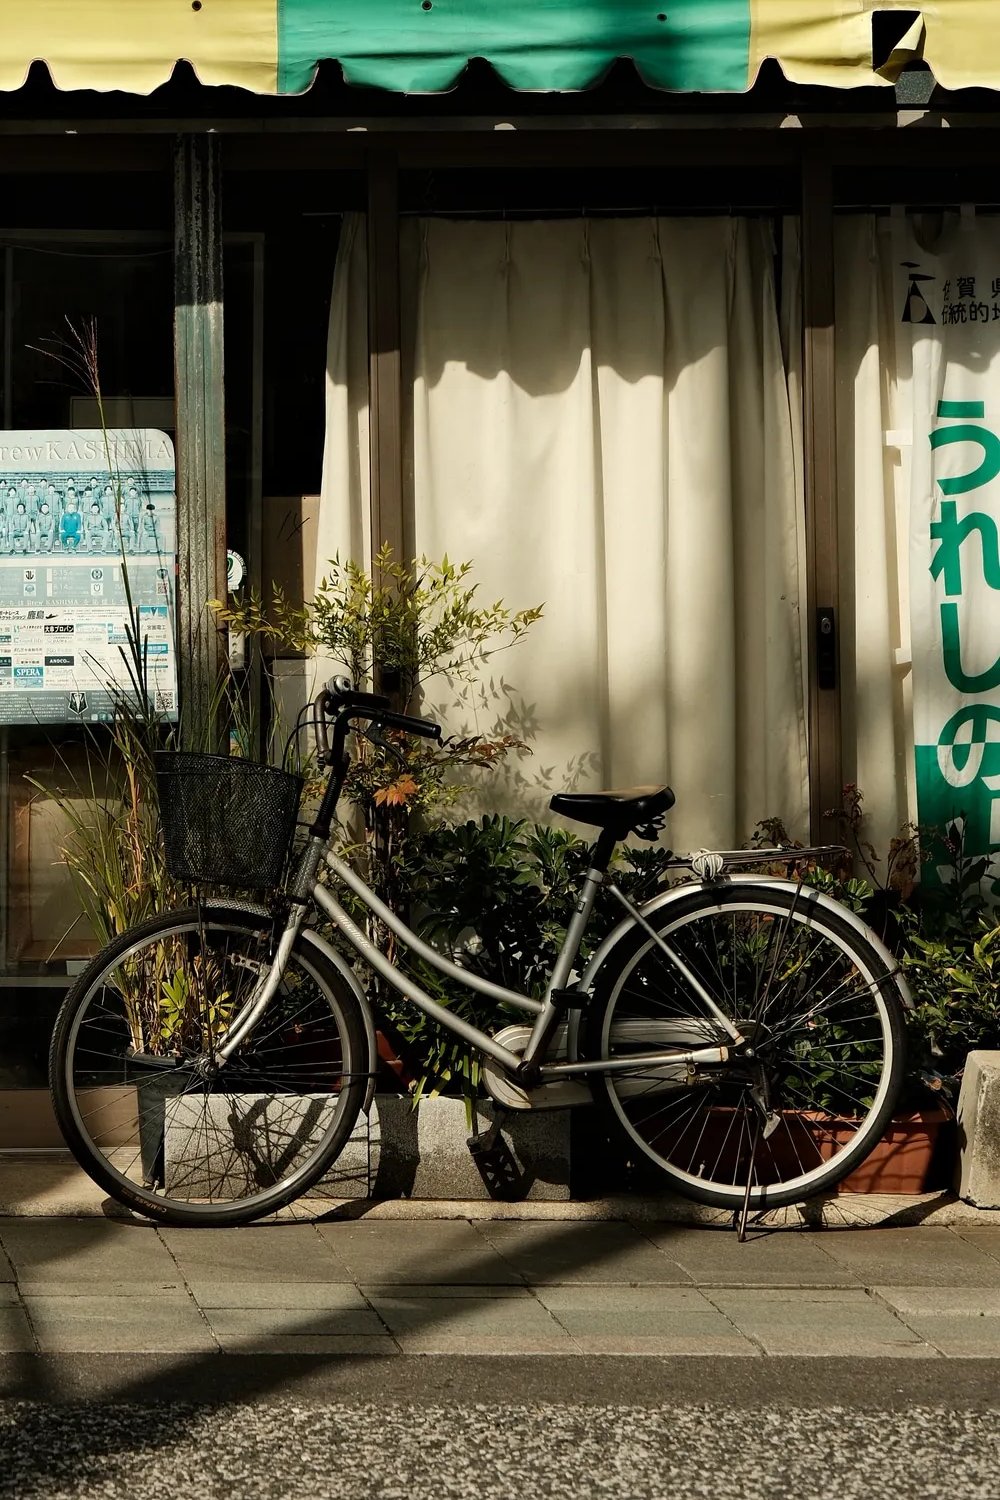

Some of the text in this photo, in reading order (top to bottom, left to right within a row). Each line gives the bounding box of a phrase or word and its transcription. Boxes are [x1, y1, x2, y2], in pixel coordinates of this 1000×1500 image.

[45, 598, 79, 606] KASHIMA
[27, 610, 45, 620] 鹿島
[16, 668, 41, 676] SPERA
